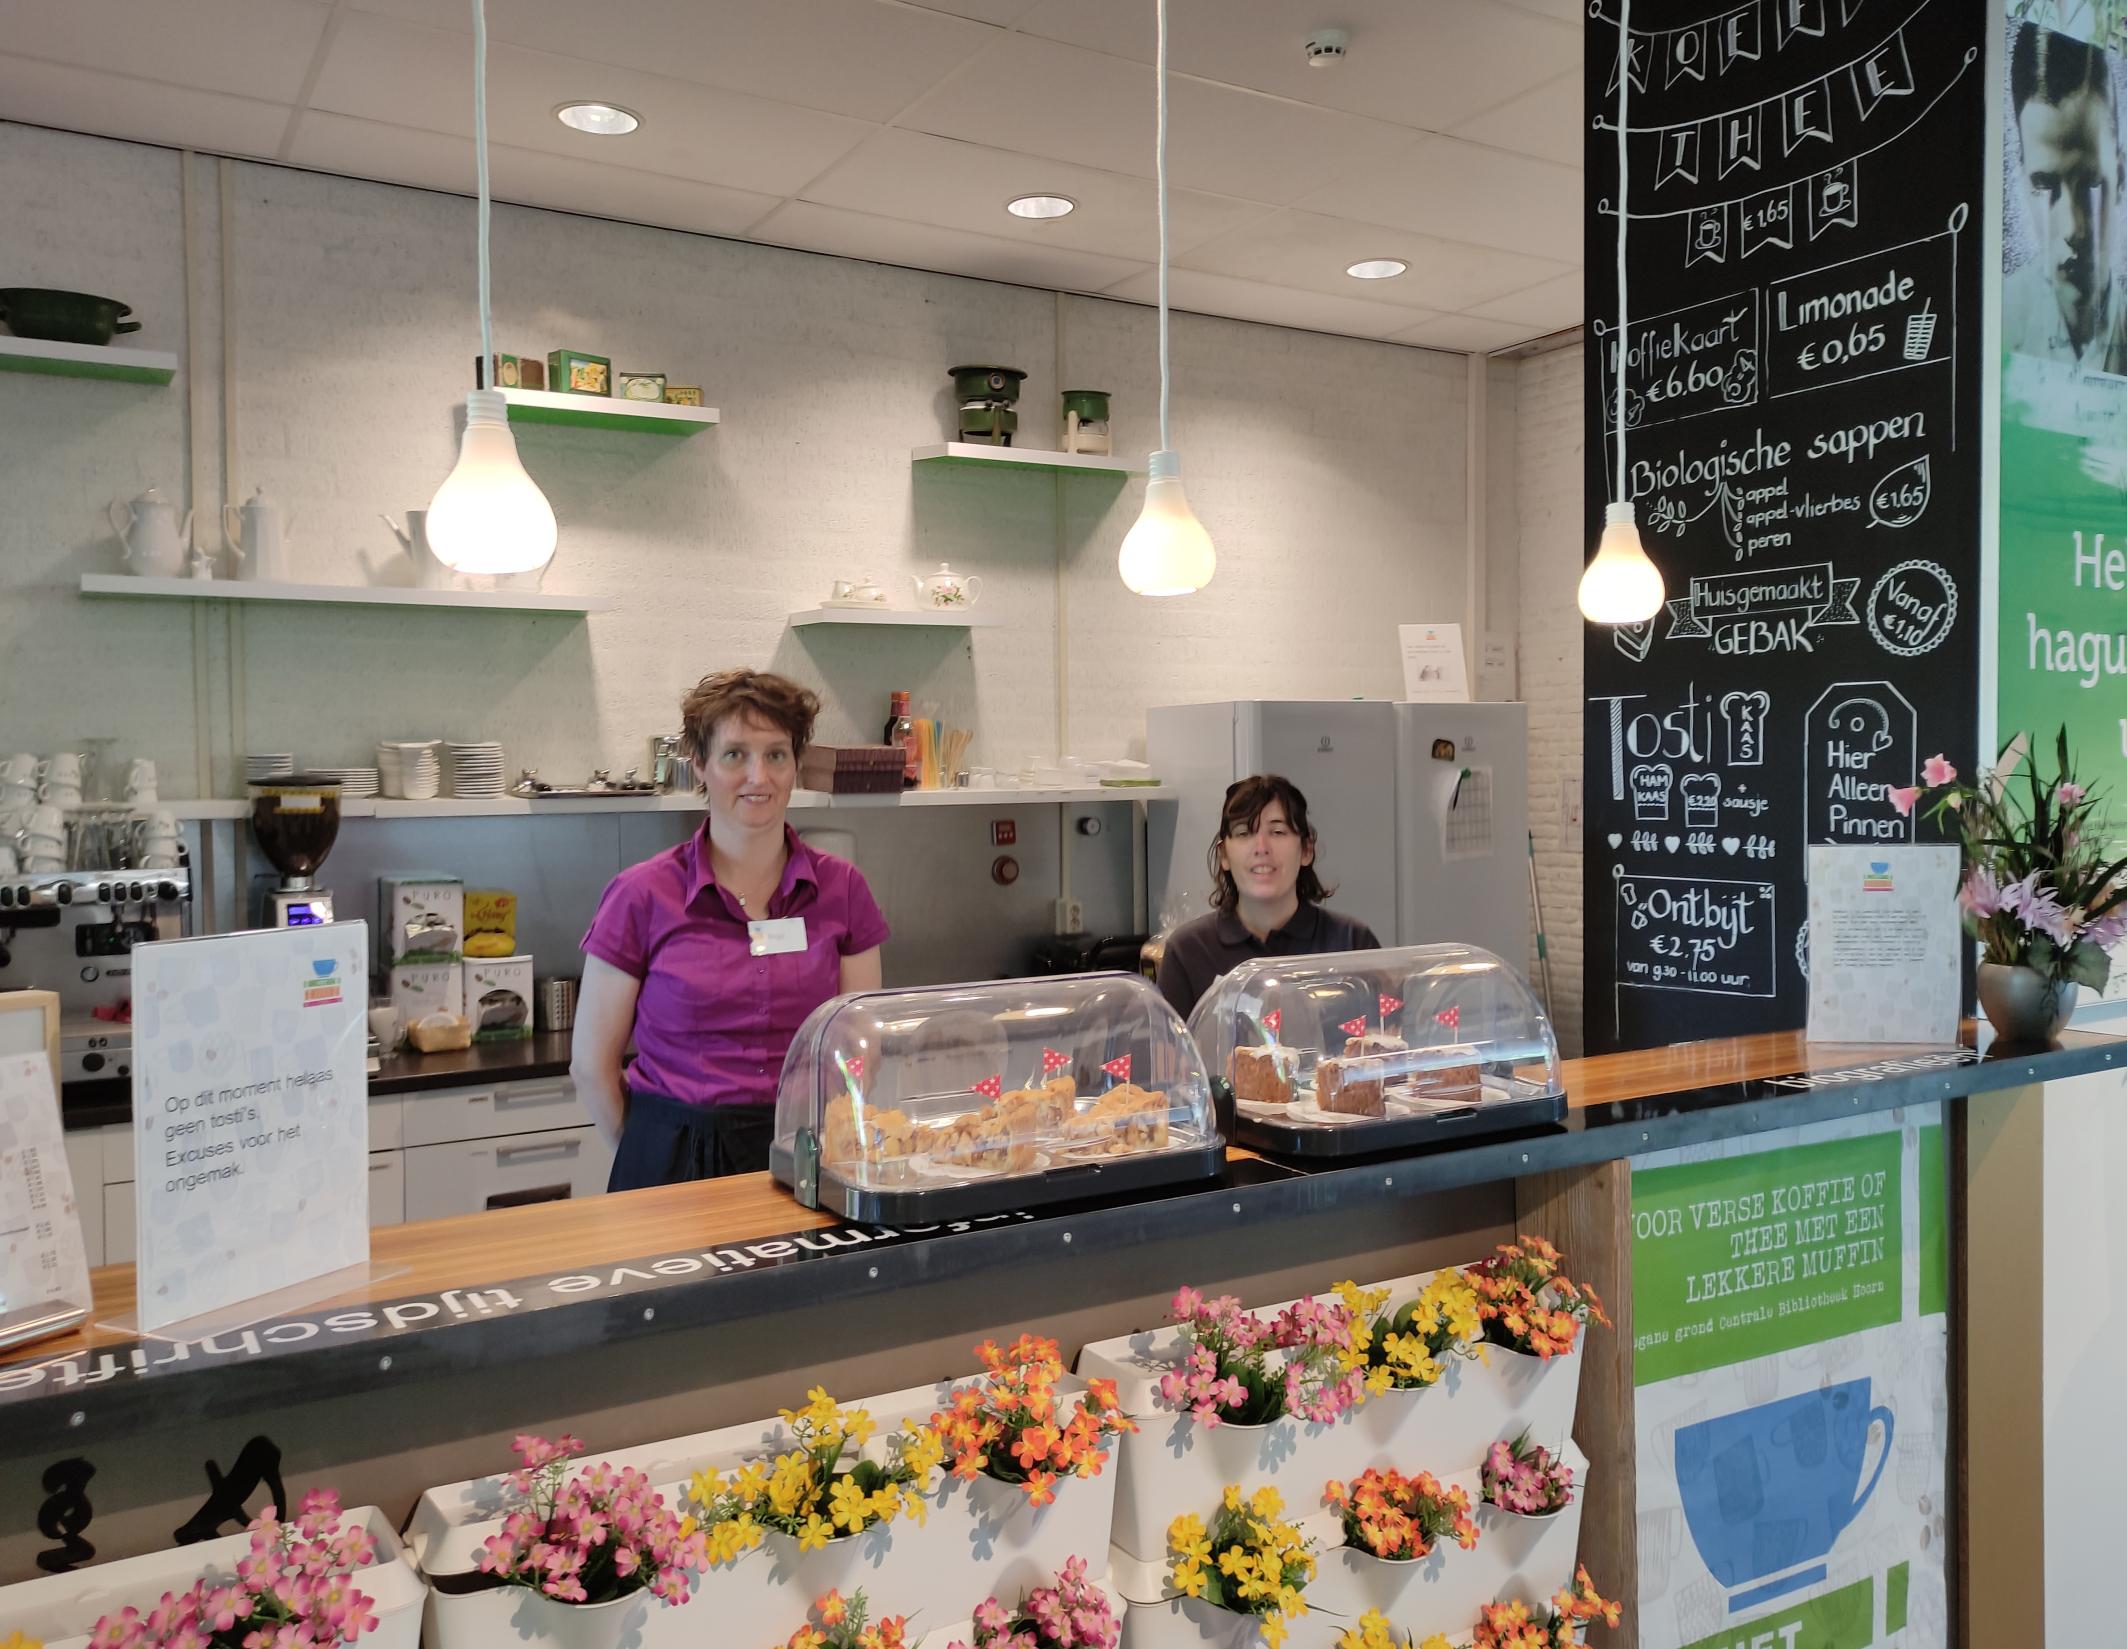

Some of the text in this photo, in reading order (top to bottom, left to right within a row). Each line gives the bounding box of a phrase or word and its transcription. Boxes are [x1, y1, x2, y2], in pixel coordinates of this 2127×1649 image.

[1671, 47, 1895, 166] THEE
[1777, 270, 1914, 332] Limonade
[1630, 411, 1926, 499] Biologische sappen
[1745, 478, 1789, 505] appel
[1748, 532, 1791, 557] peren
[2073, 531, 2127, 591] He
[1694, 575, 1824, 613] Huisgemaakt
[1888, 577, 1948, 637] Vanaf
[1714, 618, 1815, 655] GEBAK
[2026, 612, 2127, 689] hagu
[1588, 681, 1713, 800] Tosti
[1827, 740, 1877, 770] Hier
[1829, 804, 1905, 839] Pinnen
[1648, 888, 1755, 949] Ontbijt
[1631, 1171, 1887, 1240] OOR VERSE KOFFIE OF
[1730, 1204, 1885, 1259] THEE MET EEN
[1685, 1236, 1885, 1304] LEKKERE MUFFIN
